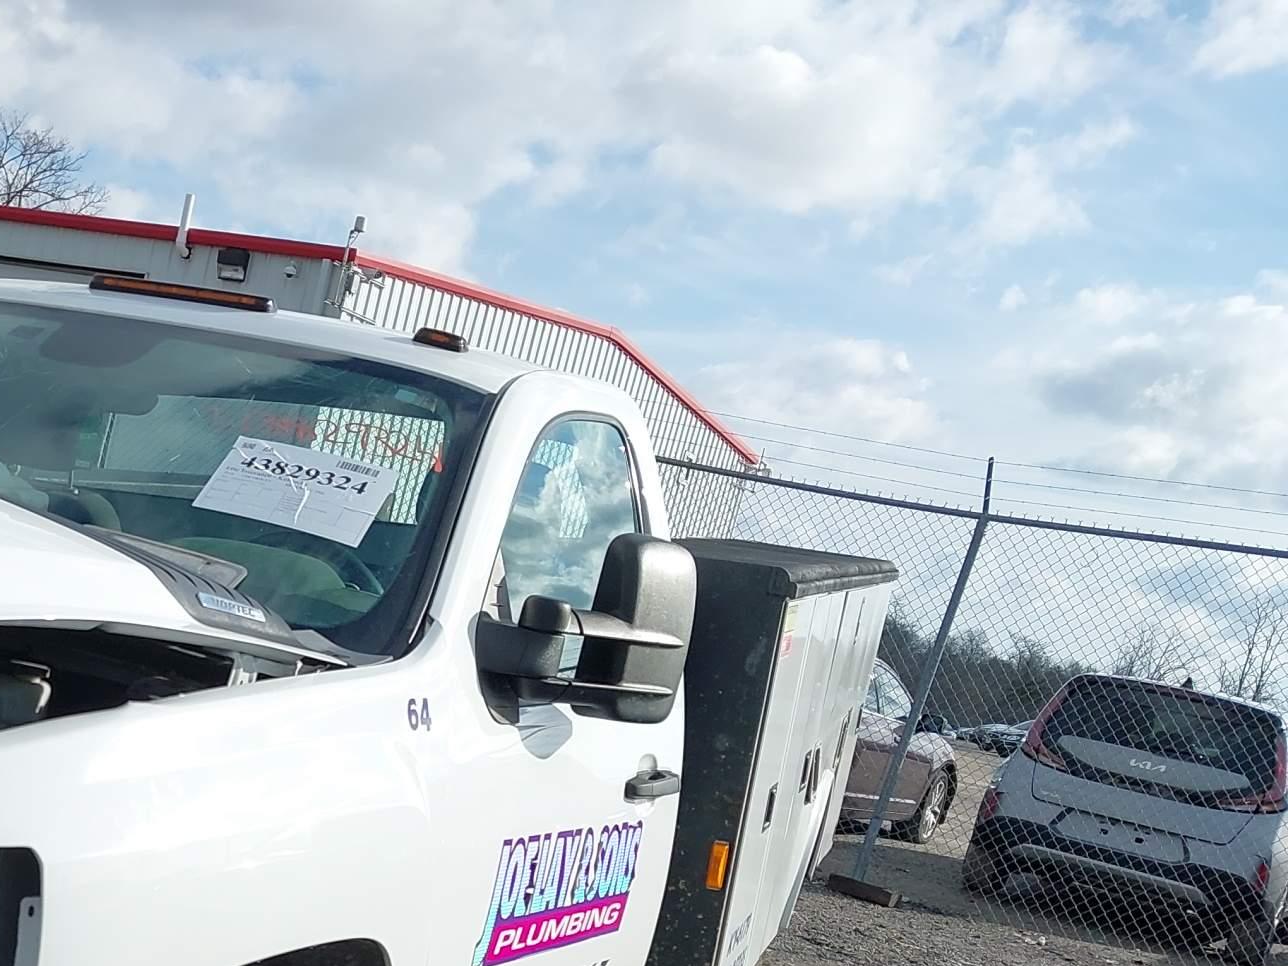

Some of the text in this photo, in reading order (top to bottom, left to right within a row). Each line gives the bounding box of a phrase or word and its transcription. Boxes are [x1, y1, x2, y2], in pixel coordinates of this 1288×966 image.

[241, 456, 369, 494] 43829324
[408, 698, 432, 731] 64
[493, 903, 622, 956] PLUMBING
